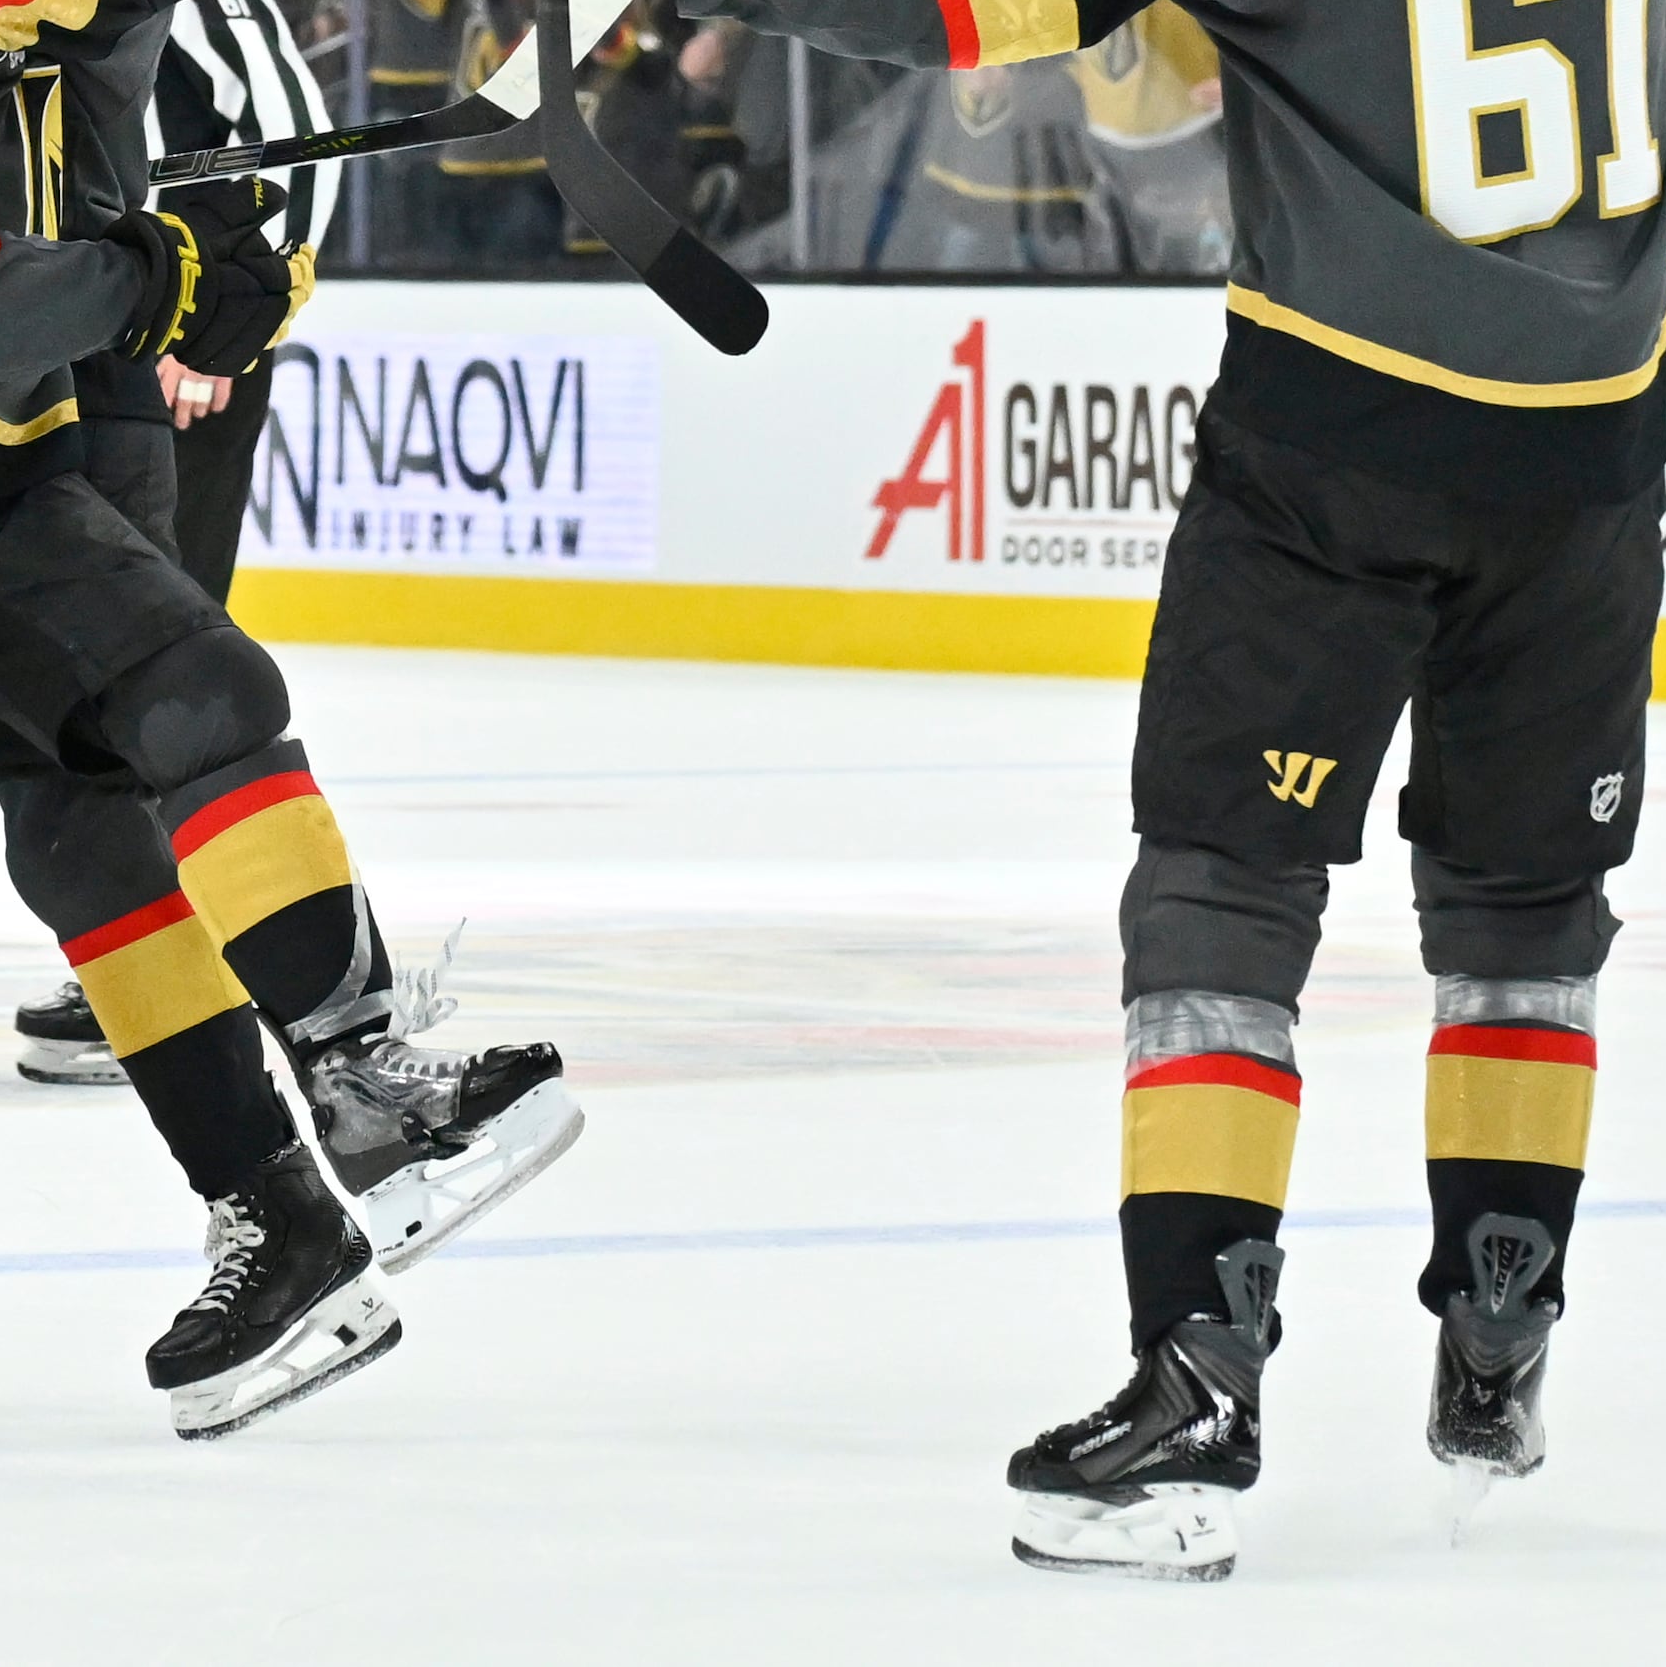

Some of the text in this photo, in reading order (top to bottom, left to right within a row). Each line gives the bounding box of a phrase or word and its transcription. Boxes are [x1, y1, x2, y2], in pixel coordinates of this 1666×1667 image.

[336, 355, 583, 503] NAQVI
[863, 317, 987, 562] A1
[1004, 383, 1218, 511] GARAG
[333, 511, 581, 559] INJURY LAW
[1003, 536, 1165, 570] DOOR SER
[376, 1240, 405, 1256] TRUE
